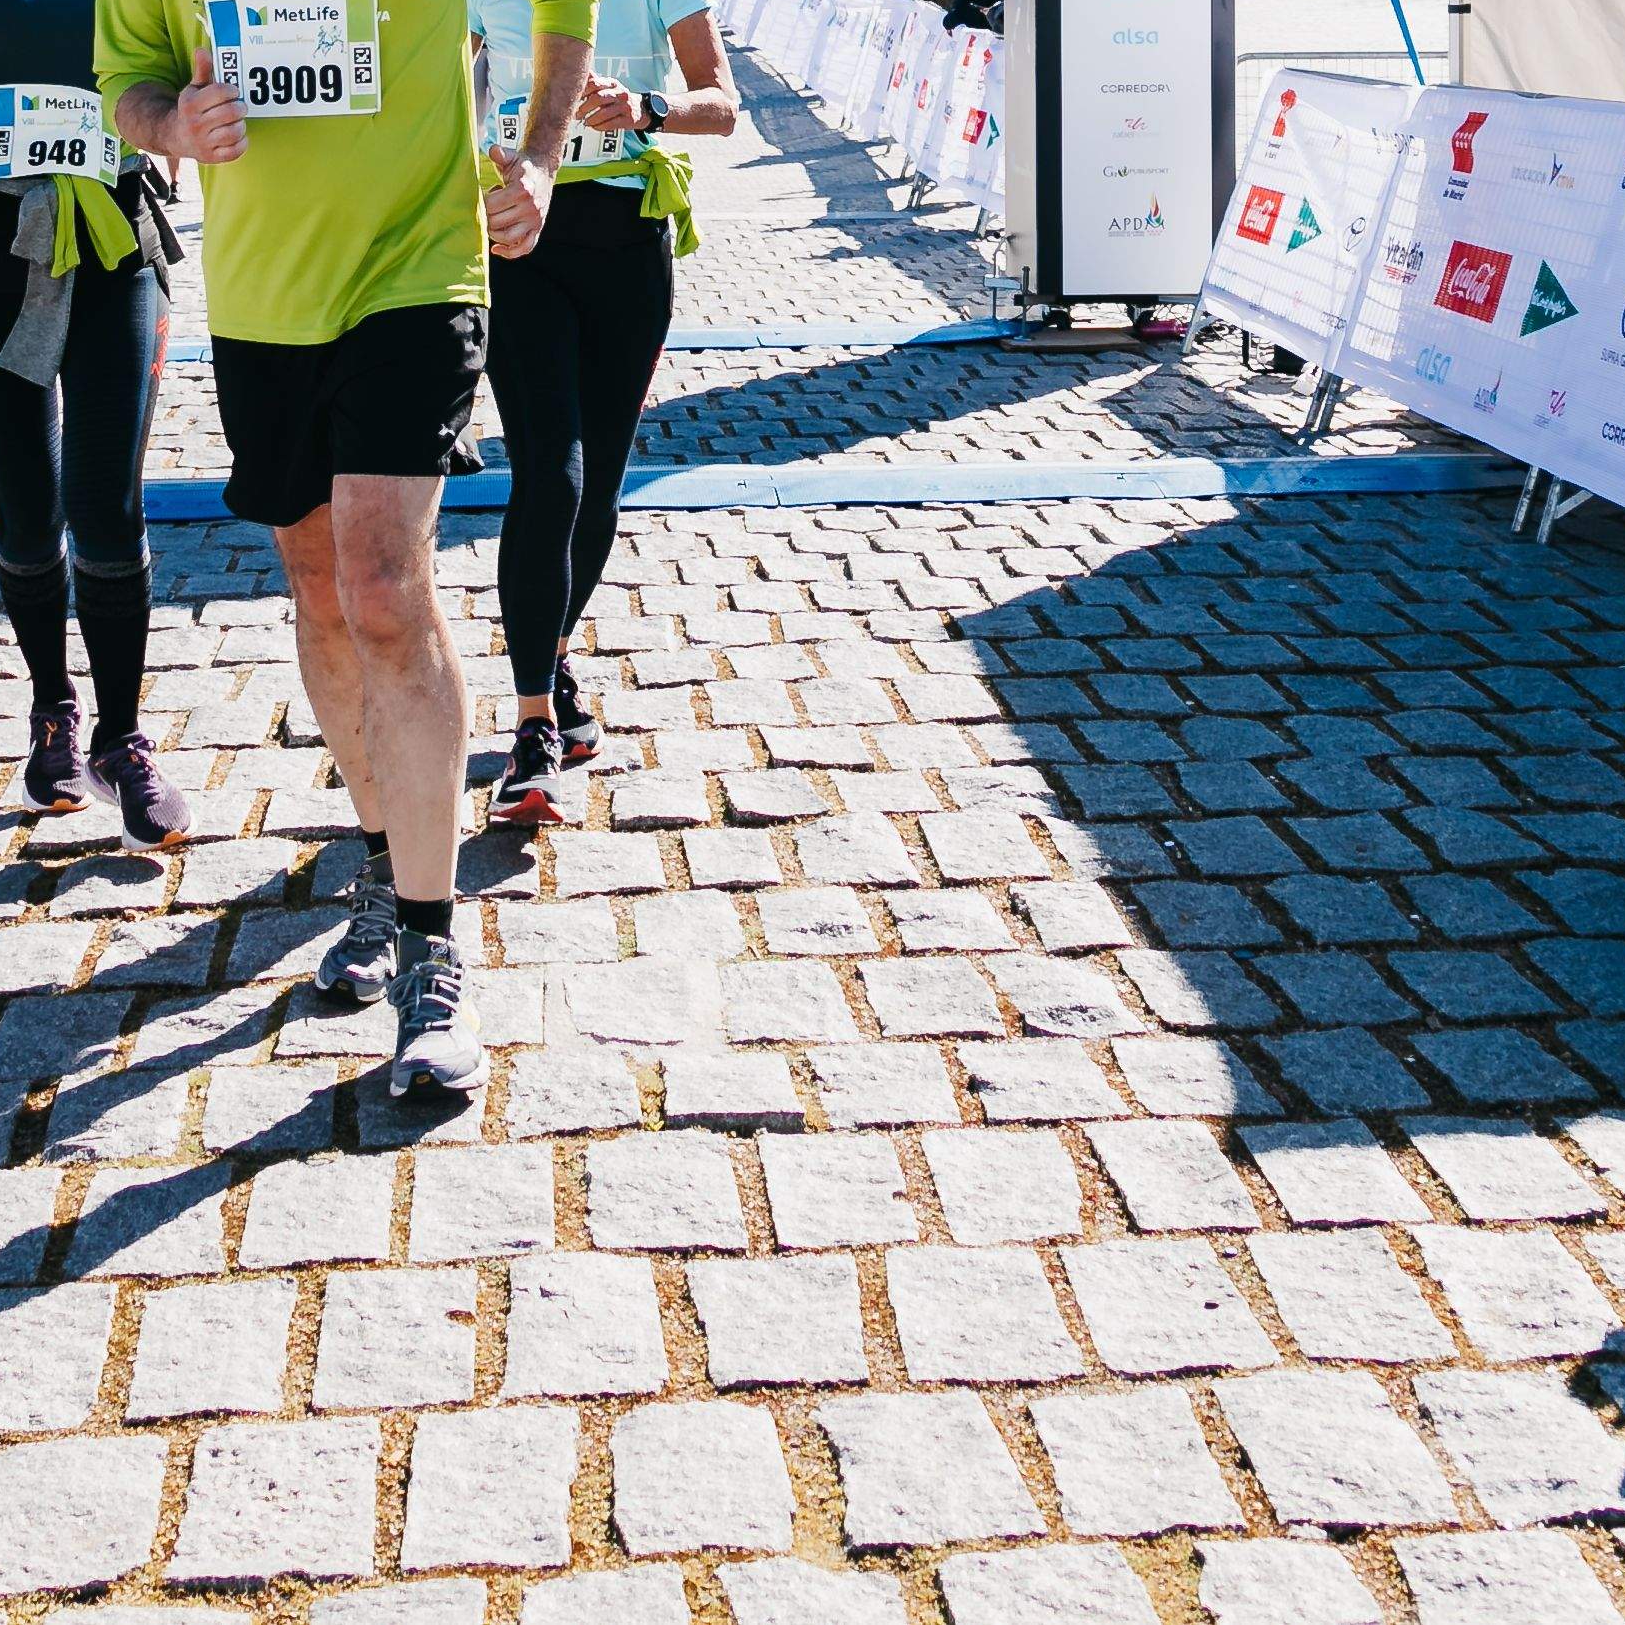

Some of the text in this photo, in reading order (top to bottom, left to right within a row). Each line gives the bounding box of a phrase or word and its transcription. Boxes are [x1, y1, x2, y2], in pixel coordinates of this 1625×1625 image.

[274, 6, 339, 22] MetLife
[1112, 28, 1159, 45] alsa
[248, 64, 343, 106] 3909
[45, 97, 97, 113] MetLife
[27, 138, 87, 166] 948
[1415, 344, 1452, 384] alsa
